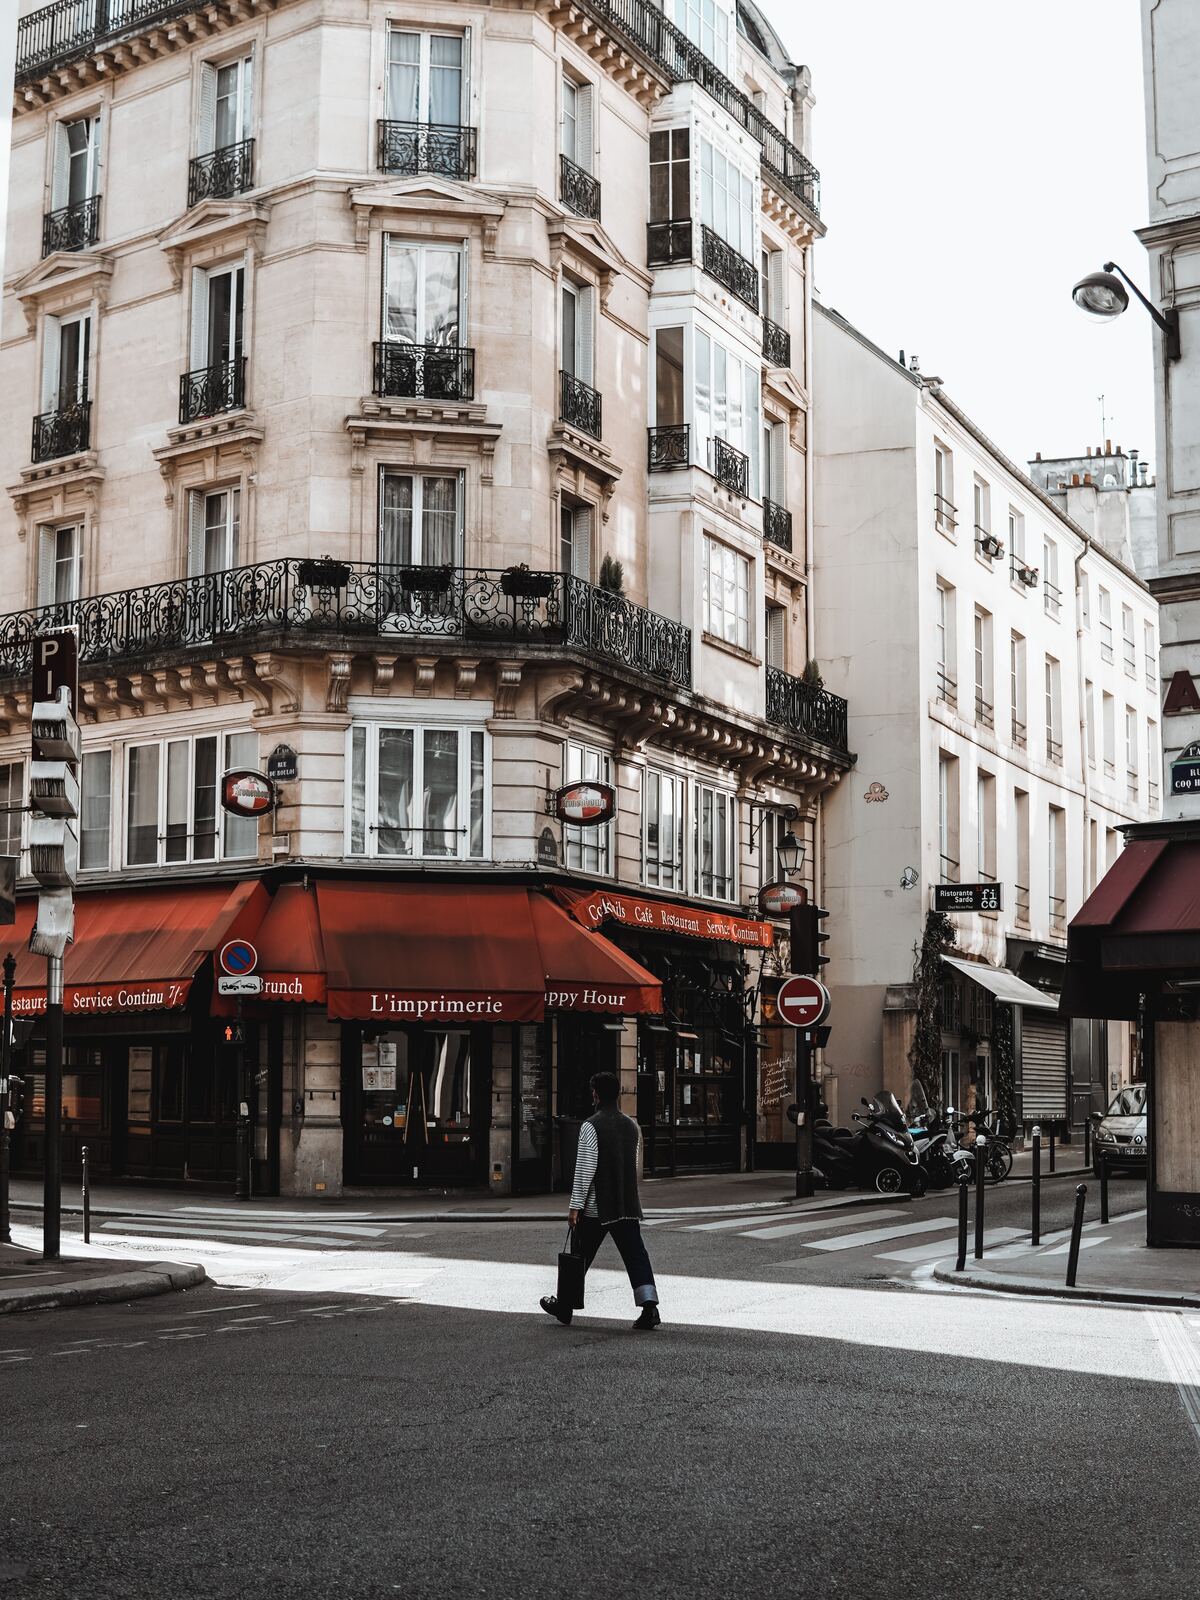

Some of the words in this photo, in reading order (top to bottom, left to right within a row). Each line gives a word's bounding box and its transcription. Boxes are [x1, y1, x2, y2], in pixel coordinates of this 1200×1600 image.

[1190, 768, 1200, 777] RU
[1175, 780, 1191, 789] COQ
[981, 888, 997, 900] fi
[634, 906, 653, 924] Café
[661, 910, 699, 932] Restaurant
[706, 919, 731, 935] Service
[731, 924, 759, 941] Continu
[11, 996, 47, 1011] estaura
[73, 992, 113, 1008] Service
[118, 990, 164, 1006] Continu
[370, 994, 503, 1017] L'imprimerie
[544, 991, 579, 1007] ppy
[582, 989, 626, 1006] Hour
